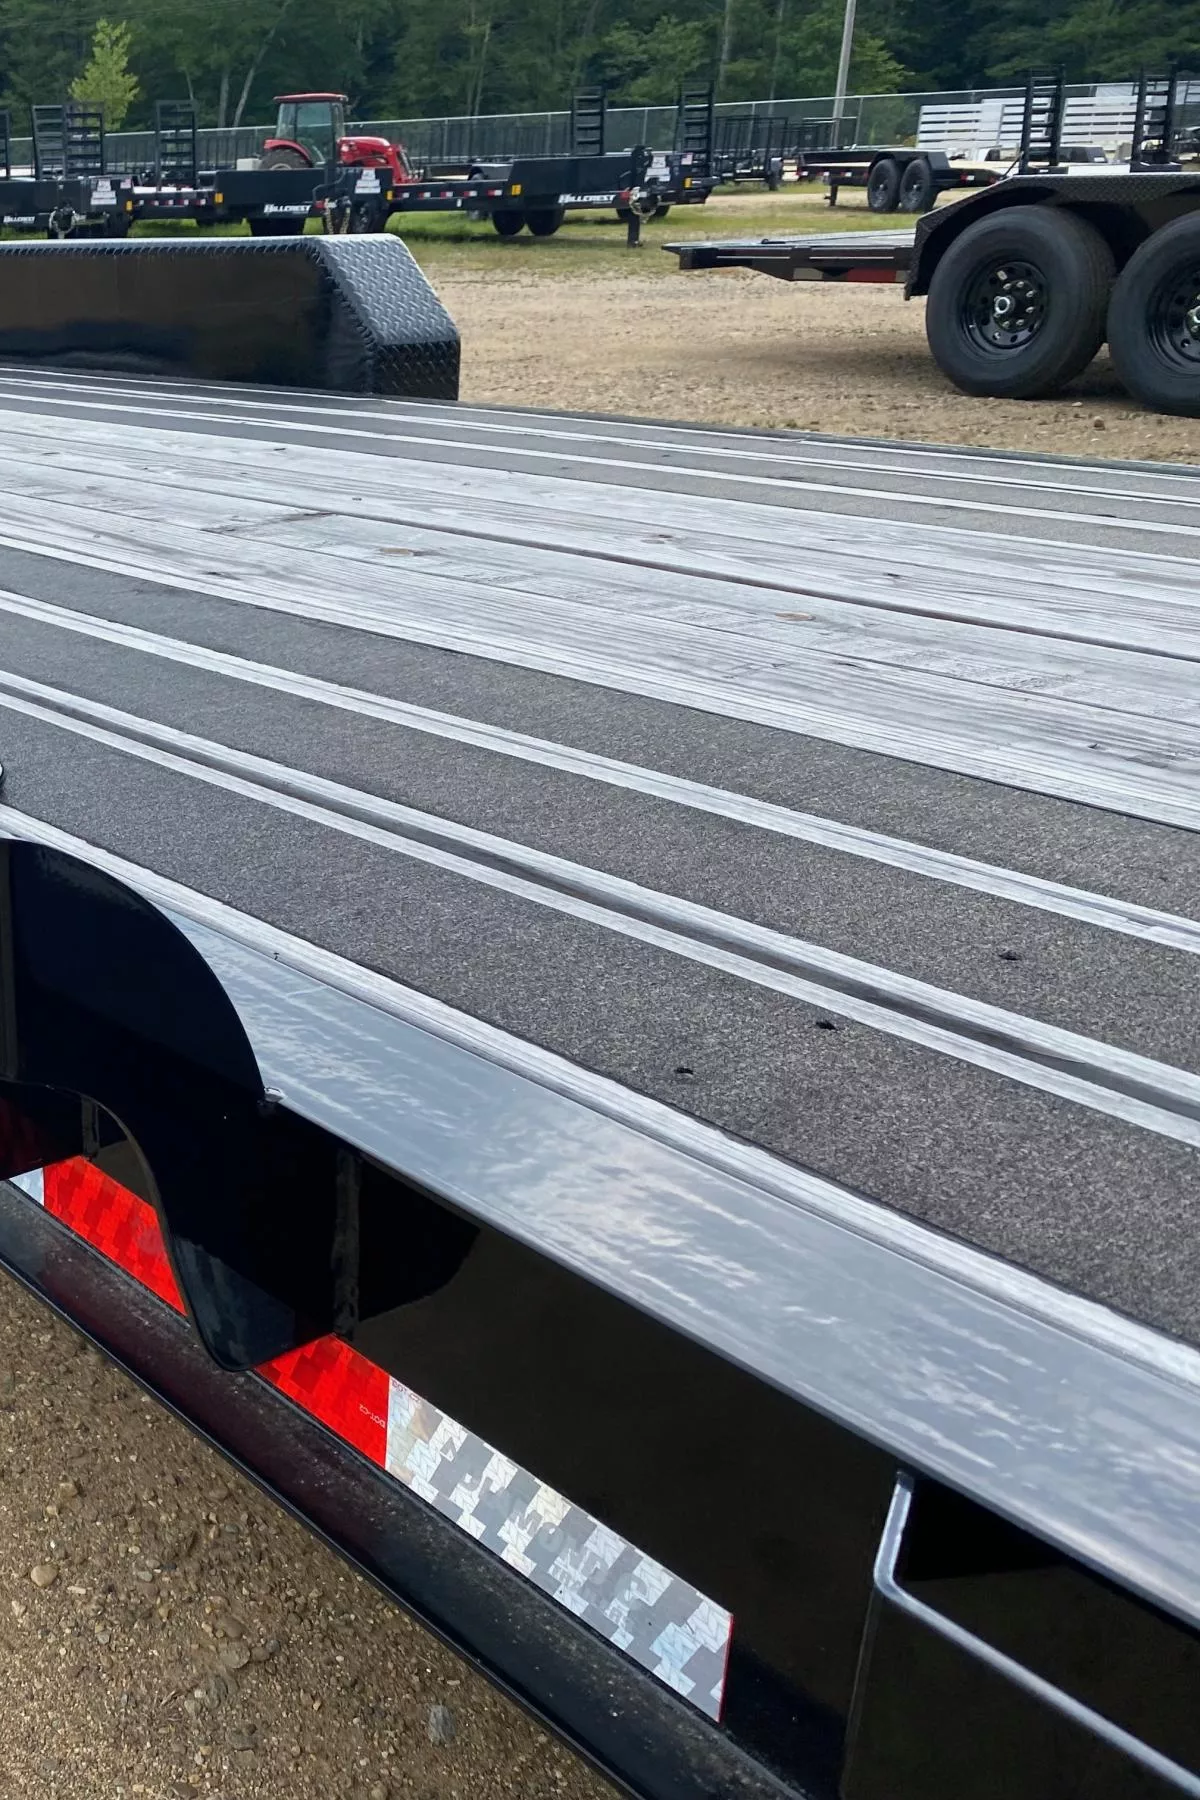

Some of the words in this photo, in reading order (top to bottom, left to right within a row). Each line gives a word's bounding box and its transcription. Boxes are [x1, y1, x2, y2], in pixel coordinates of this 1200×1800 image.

[558, 193, 616, 204] HILLCREST
[264, 204, 311, 213] HILLCREST
[359, 1404, 386, 1428] DOT-C2
